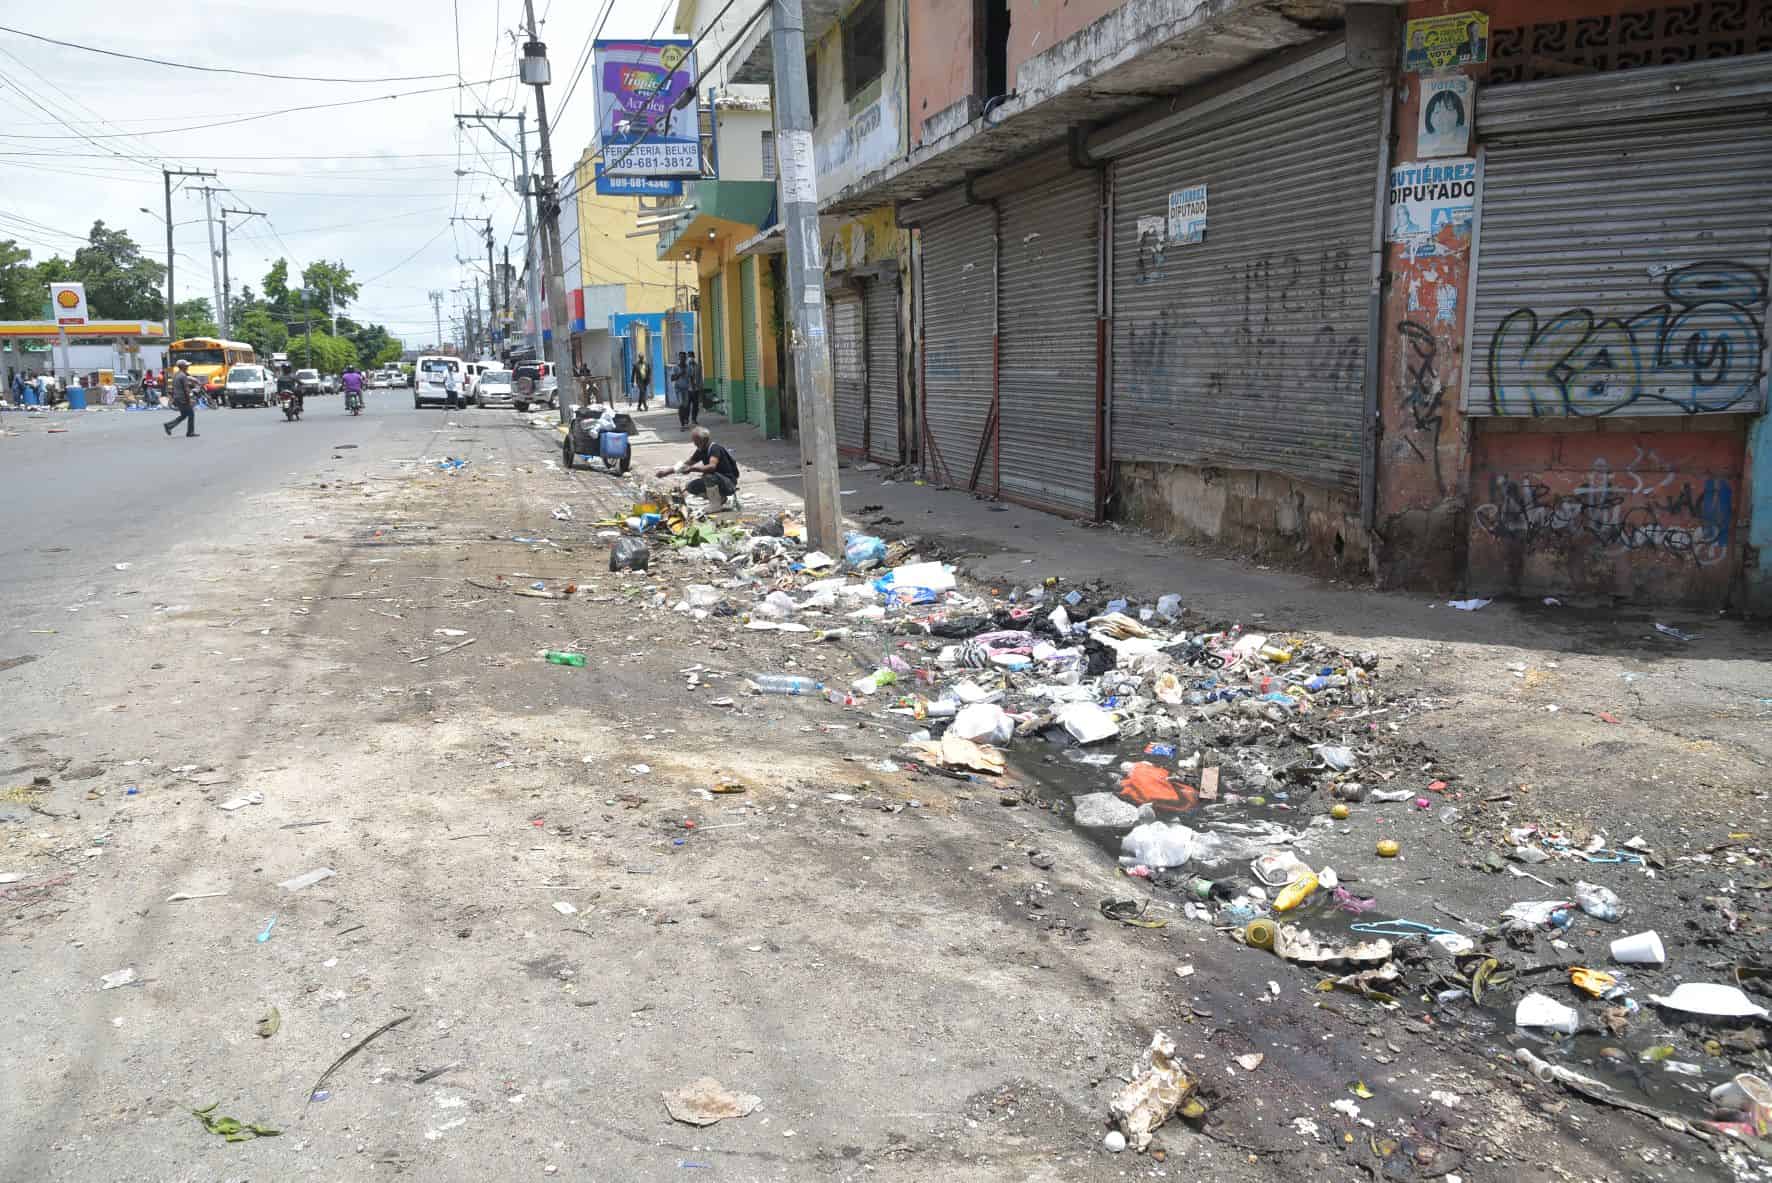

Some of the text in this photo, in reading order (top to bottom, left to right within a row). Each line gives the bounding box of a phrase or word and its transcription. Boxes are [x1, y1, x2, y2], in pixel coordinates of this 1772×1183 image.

[1430, 50, 1452, 58] VOTA
[624, 72, 672, 91] Tropicl
[1458, 79, 1467, 93] 3
[665, 145, 697, 156] BELKIS
[611, 157, 693, 168] 809-681-3812
[1390, 181, 1475, 206] DIPUTADO
[1171, 201, 1205, 218] DIPUTADO
